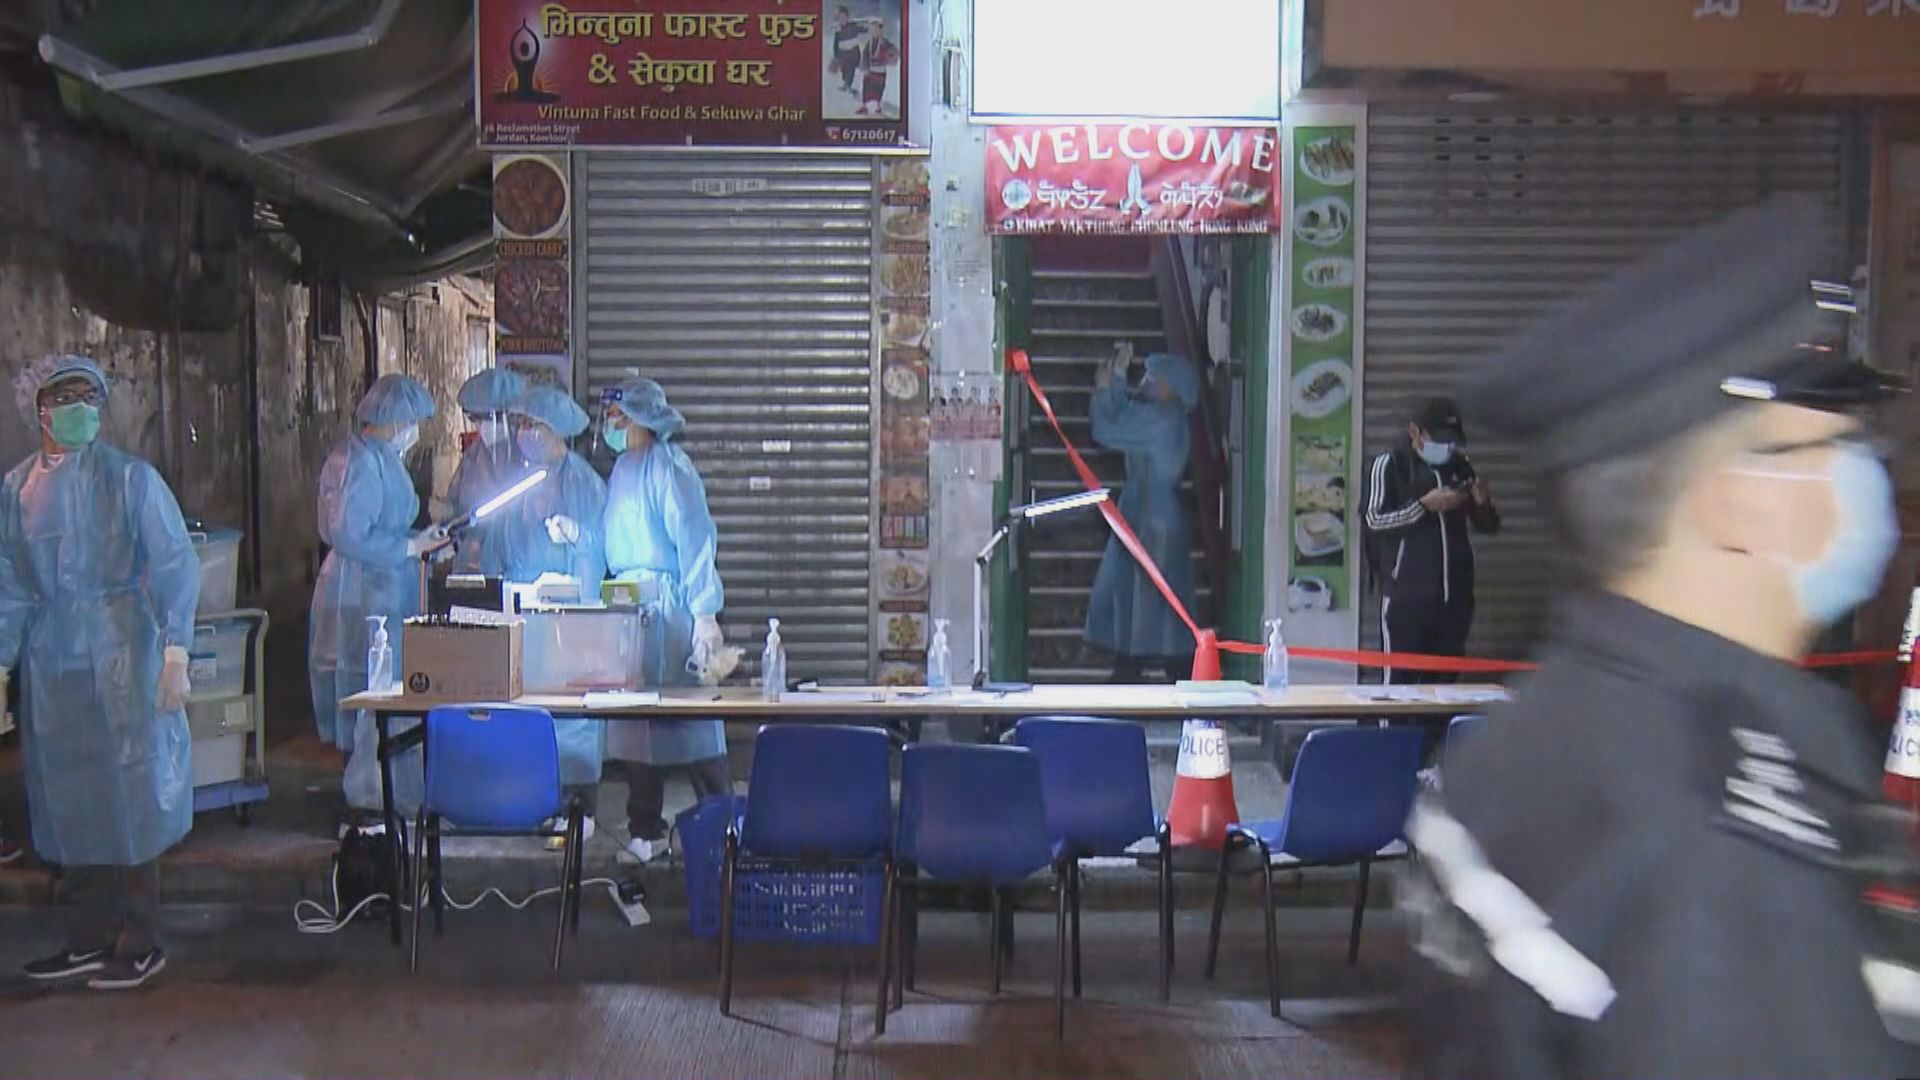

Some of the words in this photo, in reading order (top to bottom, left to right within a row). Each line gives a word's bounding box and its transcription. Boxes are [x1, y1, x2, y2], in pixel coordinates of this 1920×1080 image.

[588, 54, 617, 84] &
[537, 103, 600, 120] Vintuna
[603, 104, 635, 120] Fast
[640, 104, 681, 120] Food
[684, 105, 697, 120] &
[701, 104, 764, 121] Sekuwa
[768, 105, 806, 121] Ghar
[842, 127, 896, 142] 67120617
[993, 122, 1275, 173] WELCOME
[1182, 735, 1225, 756] OLICE
